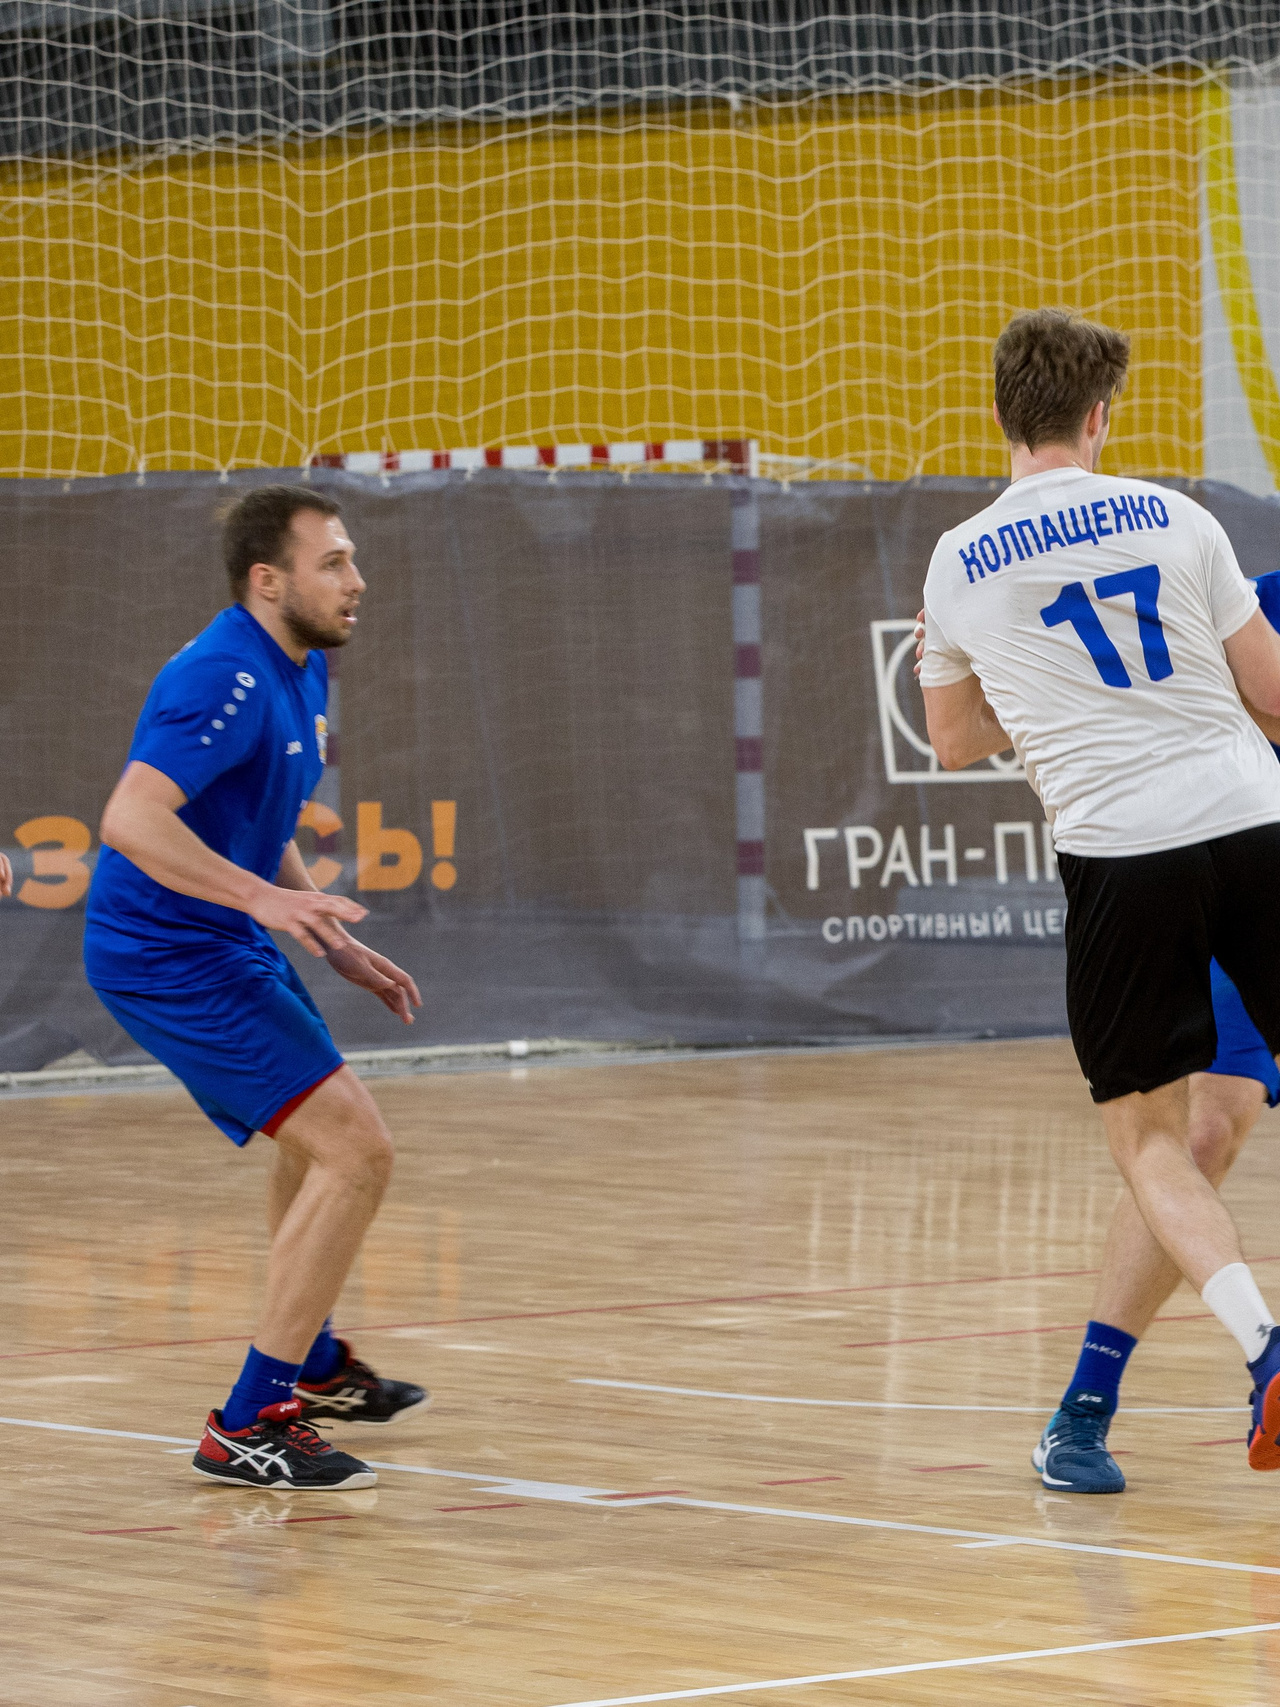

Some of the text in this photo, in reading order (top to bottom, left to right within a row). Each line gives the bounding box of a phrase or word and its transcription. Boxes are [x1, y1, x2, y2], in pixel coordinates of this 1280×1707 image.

[958, 494, 1170, 584] КОЛПАЩЕНКО
[1039, 563, 1174, 688] 17
[821, 904, 1062, 944] СПОРТИВНЫЙ ЦЕ
